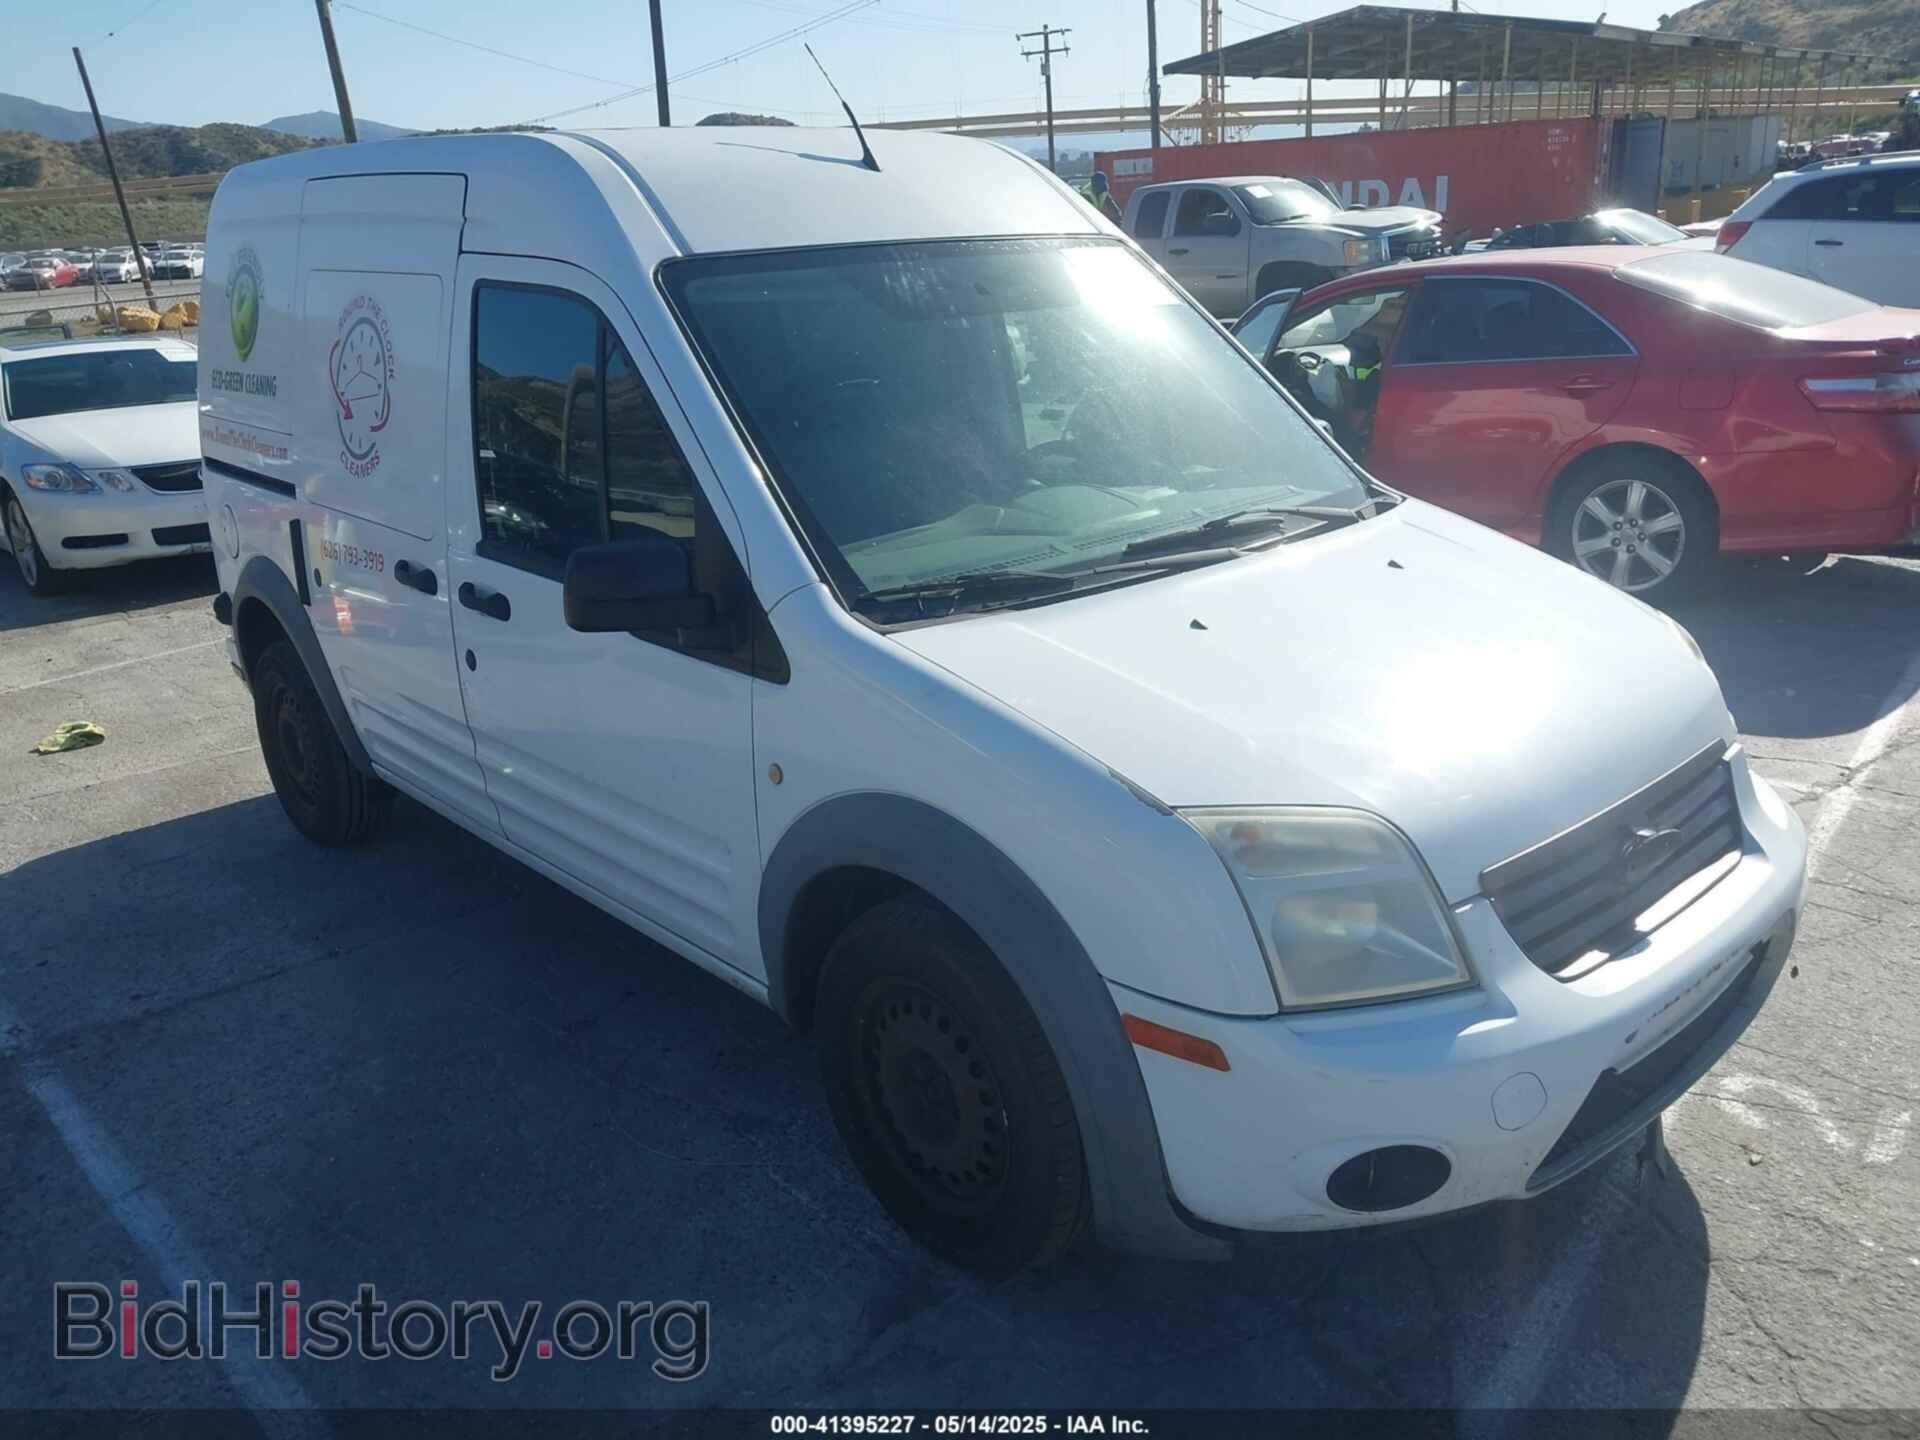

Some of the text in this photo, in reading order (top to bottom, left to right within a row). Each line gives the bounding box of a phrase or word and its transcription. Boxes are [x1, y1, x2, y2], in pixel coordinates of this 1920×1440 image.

[380, 318, 397, 379] CLOCK
[211, 369, 278, 399] ECO-GREEN CLEANING
[339, 450, 380, 479] CLEANERS
[342, 544, 385, 573] 793-3919
